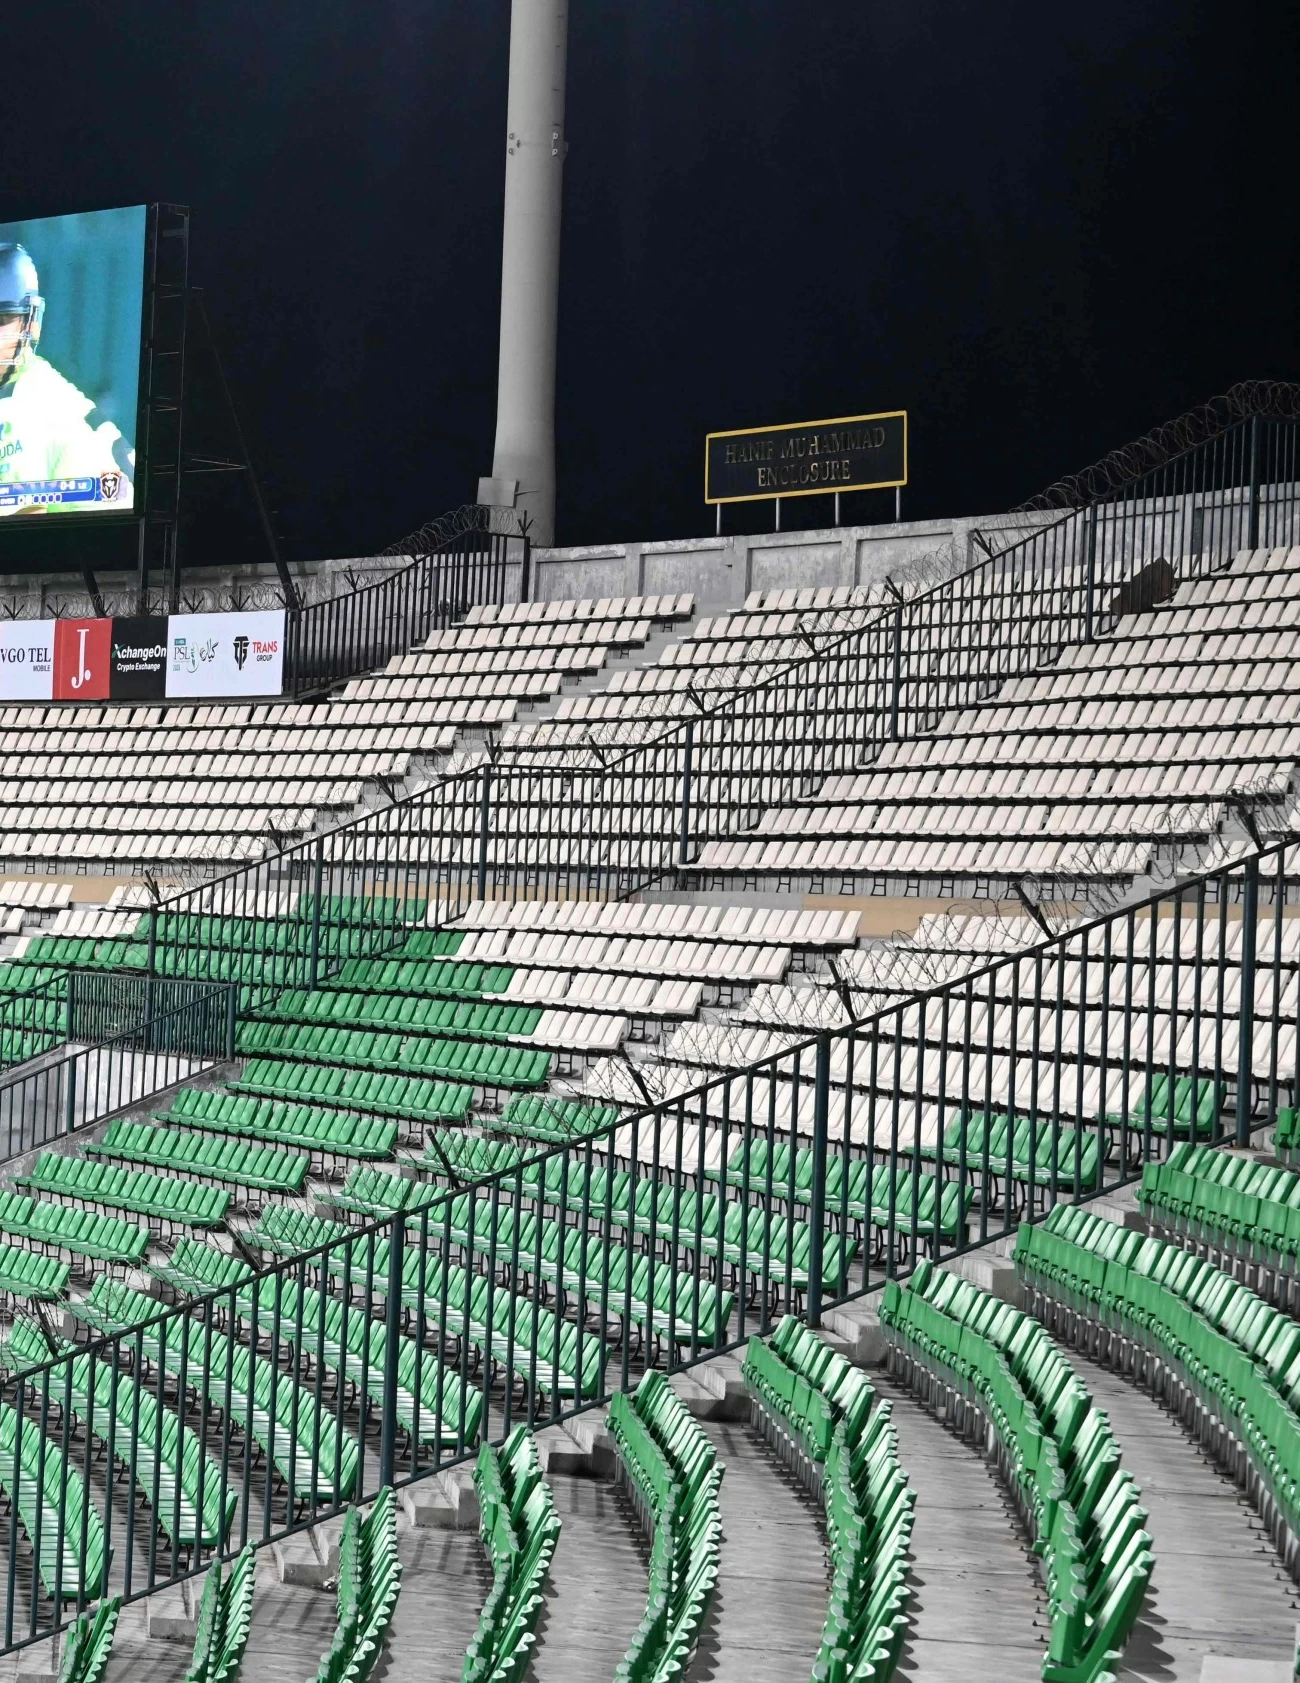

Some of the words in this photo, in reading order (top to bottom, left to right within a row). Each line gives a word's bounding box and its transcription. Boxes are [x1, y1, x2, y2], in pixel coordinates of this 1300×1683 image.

[724, 440, 773, 464] HANIF
[780, 426, 885, 459] MUHAMMAD
[758, 459, 850, 487] ENCLOSURE
[111, 643, 166, 661] XchangeOn
[173, 646, 191, 660] PSL
[252, 640, 278, 654] TRANS
[0, 648, 25, 663] VGO
[29, 647, 51, 662] TEL
[256, 654, 273, 662] GROUP
[32, 664, 51, 672] MOBILE
[116, 663, 134, 672] Crypto
[135, 662, 160, 671] Exchange
